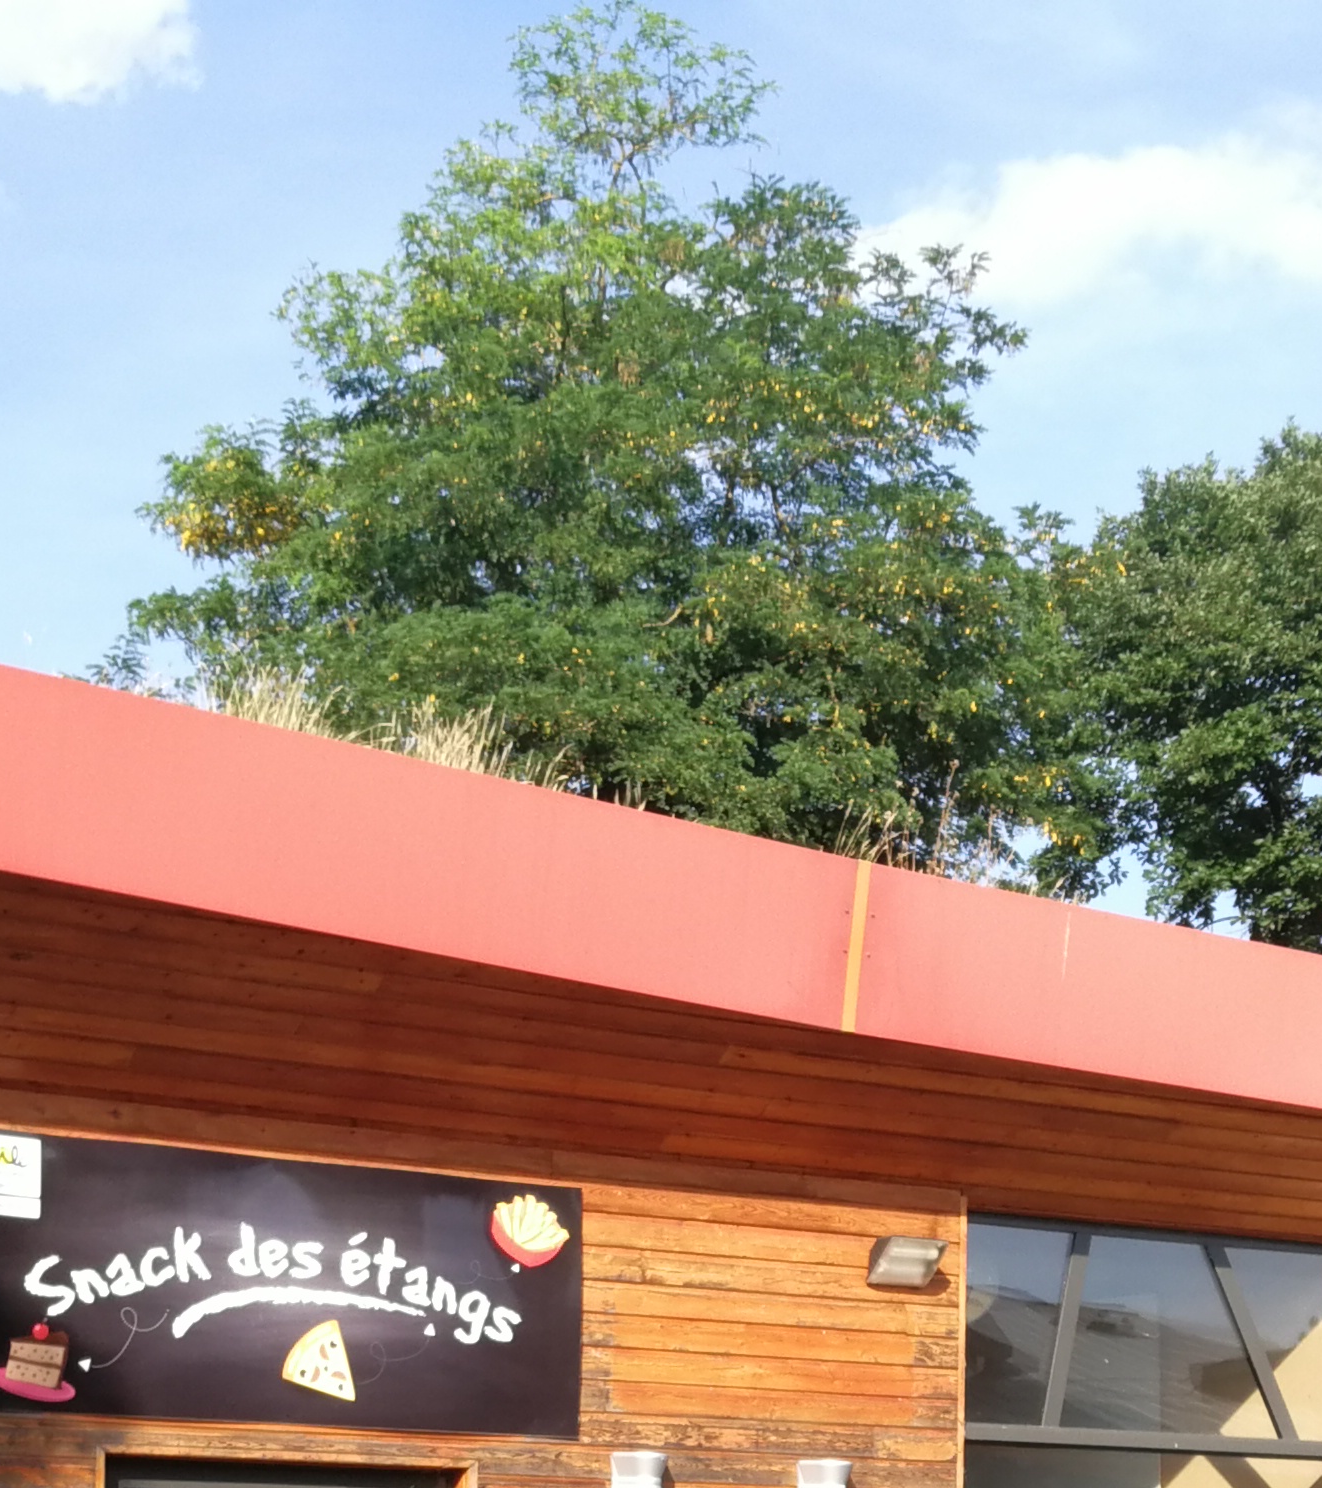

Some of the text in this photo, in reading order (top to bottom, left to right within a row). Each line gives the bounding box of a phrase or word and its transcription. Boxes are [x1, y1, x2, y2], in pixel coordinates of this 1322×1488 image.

[24, 1222, 522, 1344] Snack des étangs
